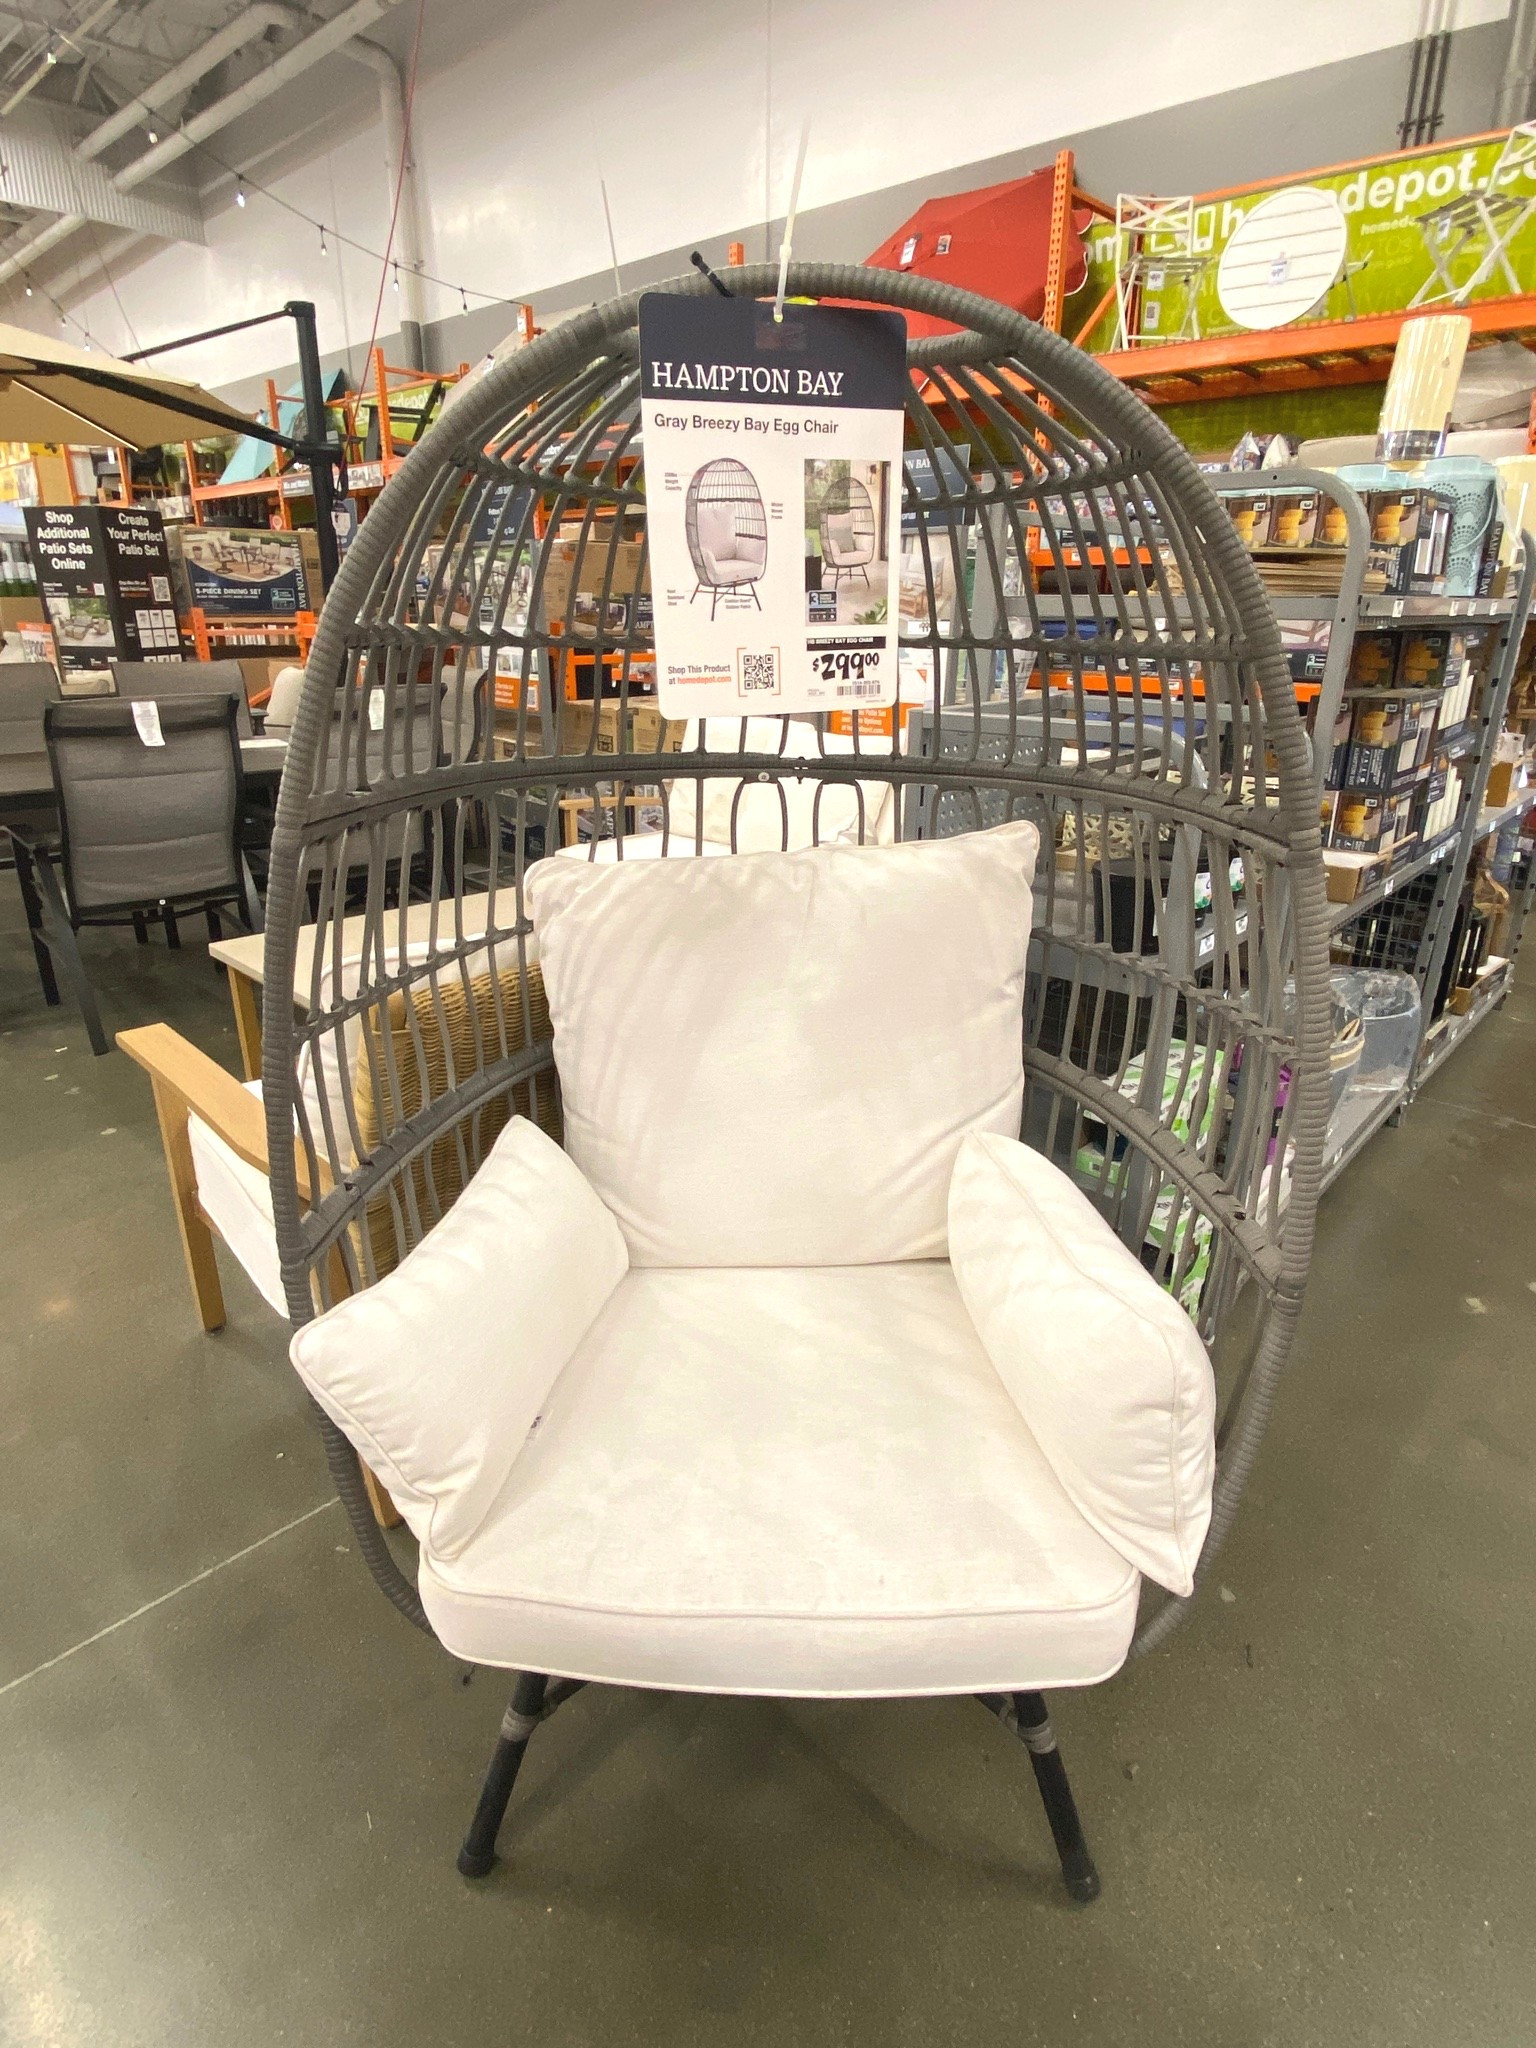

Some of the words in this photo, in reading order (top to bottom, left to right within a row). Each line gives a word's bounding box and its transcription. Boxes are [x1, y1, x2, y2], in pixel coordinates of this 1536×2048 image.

[651, 361, 790, 394] HAMPTON
[797, 369, 844, 396] BAY
[654, 413, 688, 430] Gray
[692, 415, 739, 432] Breezy
[744, 417, 769, 433] Bay
[774, 418, 799, 435] Egg
[803, 419, 838, 434] Chair
[45, 511, 74, 525] Shop
[118, 512, 149, 526] Create
[37, 527, 90, 539] Additional
[106, 527, 130, 540] Your
[131, 529, 164, 542] Perfect
[39, 543, 67, 554] Patio
[68, 543, 93, 554] Sets
[118, 544, 143, 555] Patio
[145, 545, 160, 556] Set
[51, 558, 86, 570] Online
[668, 666, 686, 675] Shop
[687, 665, 702, 673] This
[703, 664, 731, 673] Product
[668, 677, 676, 685] at
[677, 675, 732, 685] homedepot.com
